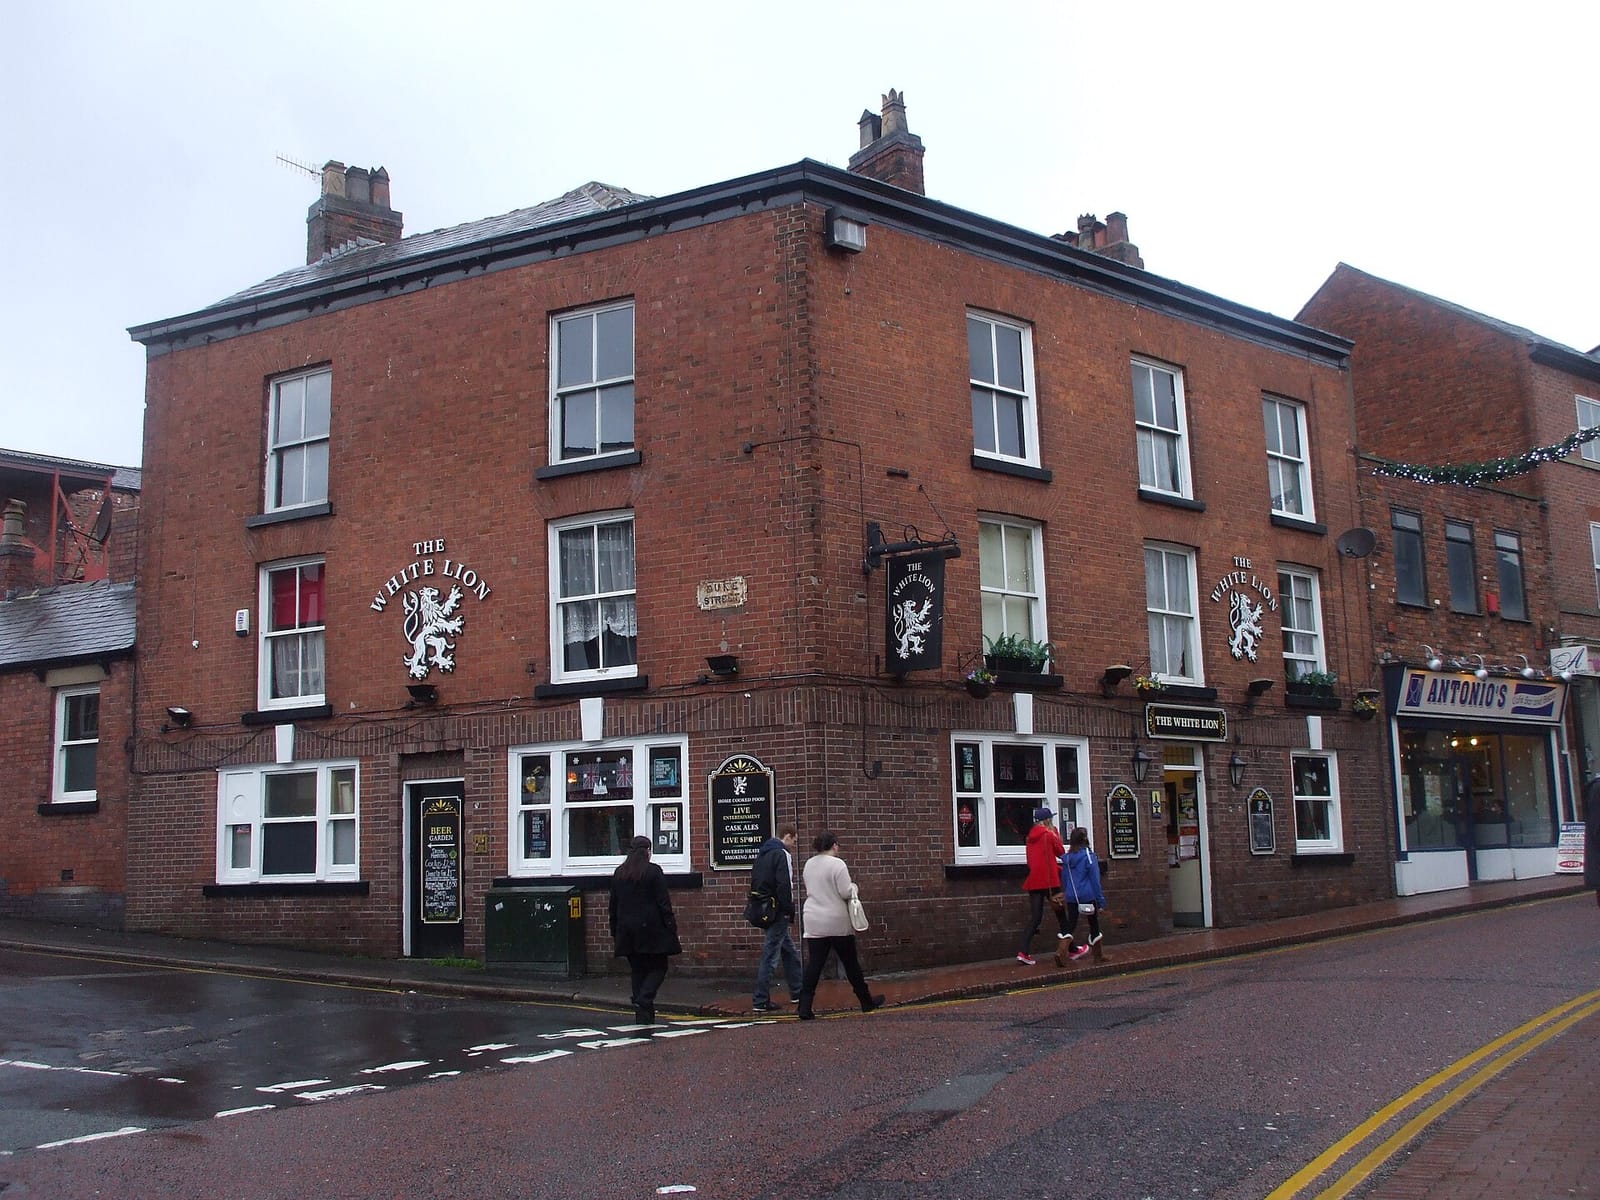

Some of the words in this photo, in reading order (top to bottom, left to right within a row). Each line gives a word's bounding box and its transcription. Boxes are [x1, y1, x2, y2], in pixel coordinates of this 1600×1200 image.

[412, 538, 446, 555] THE
[907, 562, 922, 572] THE
[1233, 556, 1252, 569] THE
[369, 558, 435, 613] WHITE
[442, 559, 492, 601] LION
[706, 581, 738, 593] DUKE
[892, 573, 918, 597] WHITE
[918, 573, 936, 594] LION
[1211, 571, 1248, 602] WHITE
[1251, 575, 1279, 612] LION
[1427, 678, 1508, 709] ANTONIO'S
[1155, 715, 1173, 726] THE
[1173, 717, 1200, 728] WHITE
[1201, 719, 1219, 730] LION
[733, 807, 751, 815] LIVE
[430, 826, 452, 835] BEER
[722, 836, 739, 844] LIVE
[739, 835, 762, 843] SPORT
